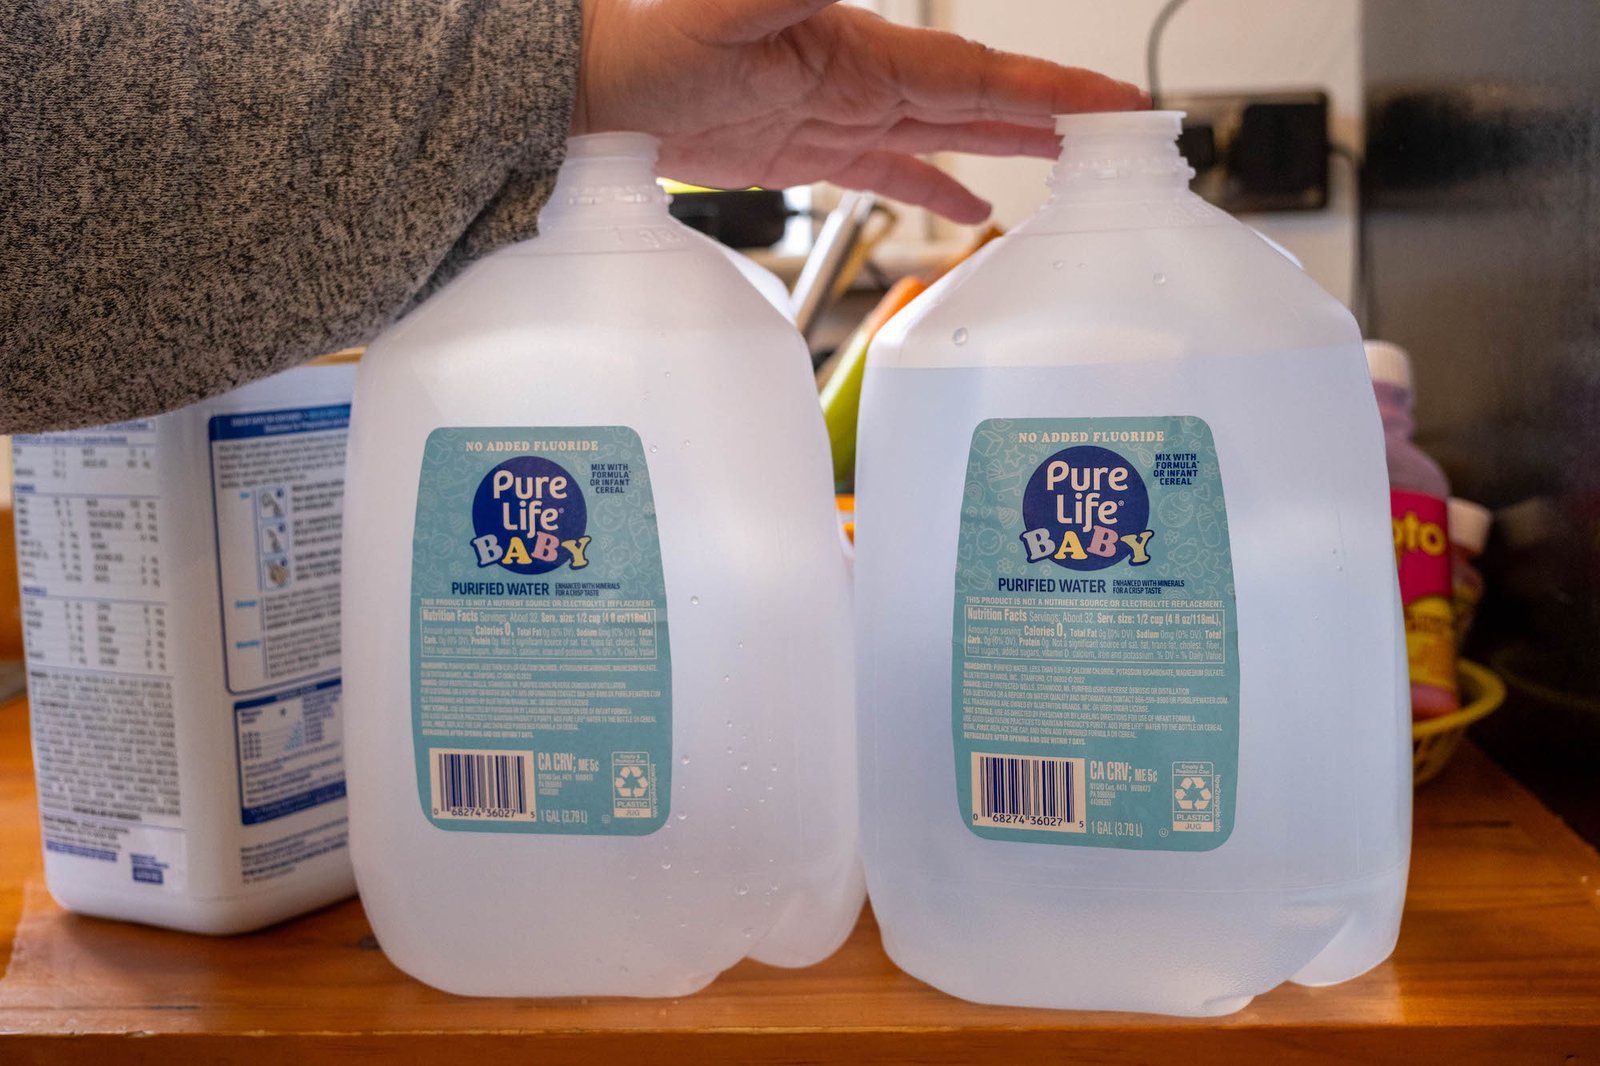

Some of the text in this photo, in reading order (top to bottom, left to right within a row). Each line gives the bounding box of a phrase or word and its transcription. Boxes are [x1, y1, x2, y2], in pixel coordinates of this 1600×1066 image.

[1018, 431, 1165, 443] NO ADDED FLUORIDE
[465, 440, 599, 452] NO ADDED FLUORIDE
[1155, 453, 1197, 462] MIX WITH
[1046, 460, 1129, 492] Pure
[1153, 469, 1199, 478] OR INFANT
[493, 470, 568, 499] Pure
[590, 478, 630, 486] OR INFANT
[1160, 478, 1192, 486] CEREAL
[595, 486, 625, 494] CEREAL
[470, 531, 592, 571] BABY
[1020, 525, 1155, 566] BABY
[452, 582, 549, 596] PURIFIED WATER
[998, 578, 1107, 594] PURIFIED WATER
[1158, 580, 1185, 588] MINERALS
[966, 596, 979, 604] THIS
[982, 597, 1012, 605] PRODUCT
[1045, 598, 1078, 606] NUTRIENT
[1080, 599, 1109, 607] SOURCE
[1122, 600, 1170, 608] ELECTROLYTE
[1172, 600, 1225, 608] REPLACEMENT.
[968, 608, 1002, 620] Nutrition
[1005, 609, 1027, 621] Facts
[1097, 613, 1115, 624] Serv.
[1118, 614, 1134, 624] size:
[1137, 614, 1148, 625] 1/2
[1151, 616, 1164, 626] cup
[475, 625, 504, 636] Calories
[1024, 625, 1054, 637] Calories
[1070, 628, 1087, 637] Total
[1087, 629, 1098, 638] Fat
[1205, 630, 1222, 640] Total
[538, 753, 551, 771] CA
[1090, 761, 1105, 780] CA
[1135, 769, 1147, 782] ME
[451, 807, 482, 817] 68274
[486, 808, 516, 819] 36027
[992, 814, 1025, 825] 68274
[1030, 816, 1064, 828] 36027
[1079, 821, 1084, 829] 5
[1097, 821, 1112, 835] GAL
[1115, 822, 1135, 836] (3.79
